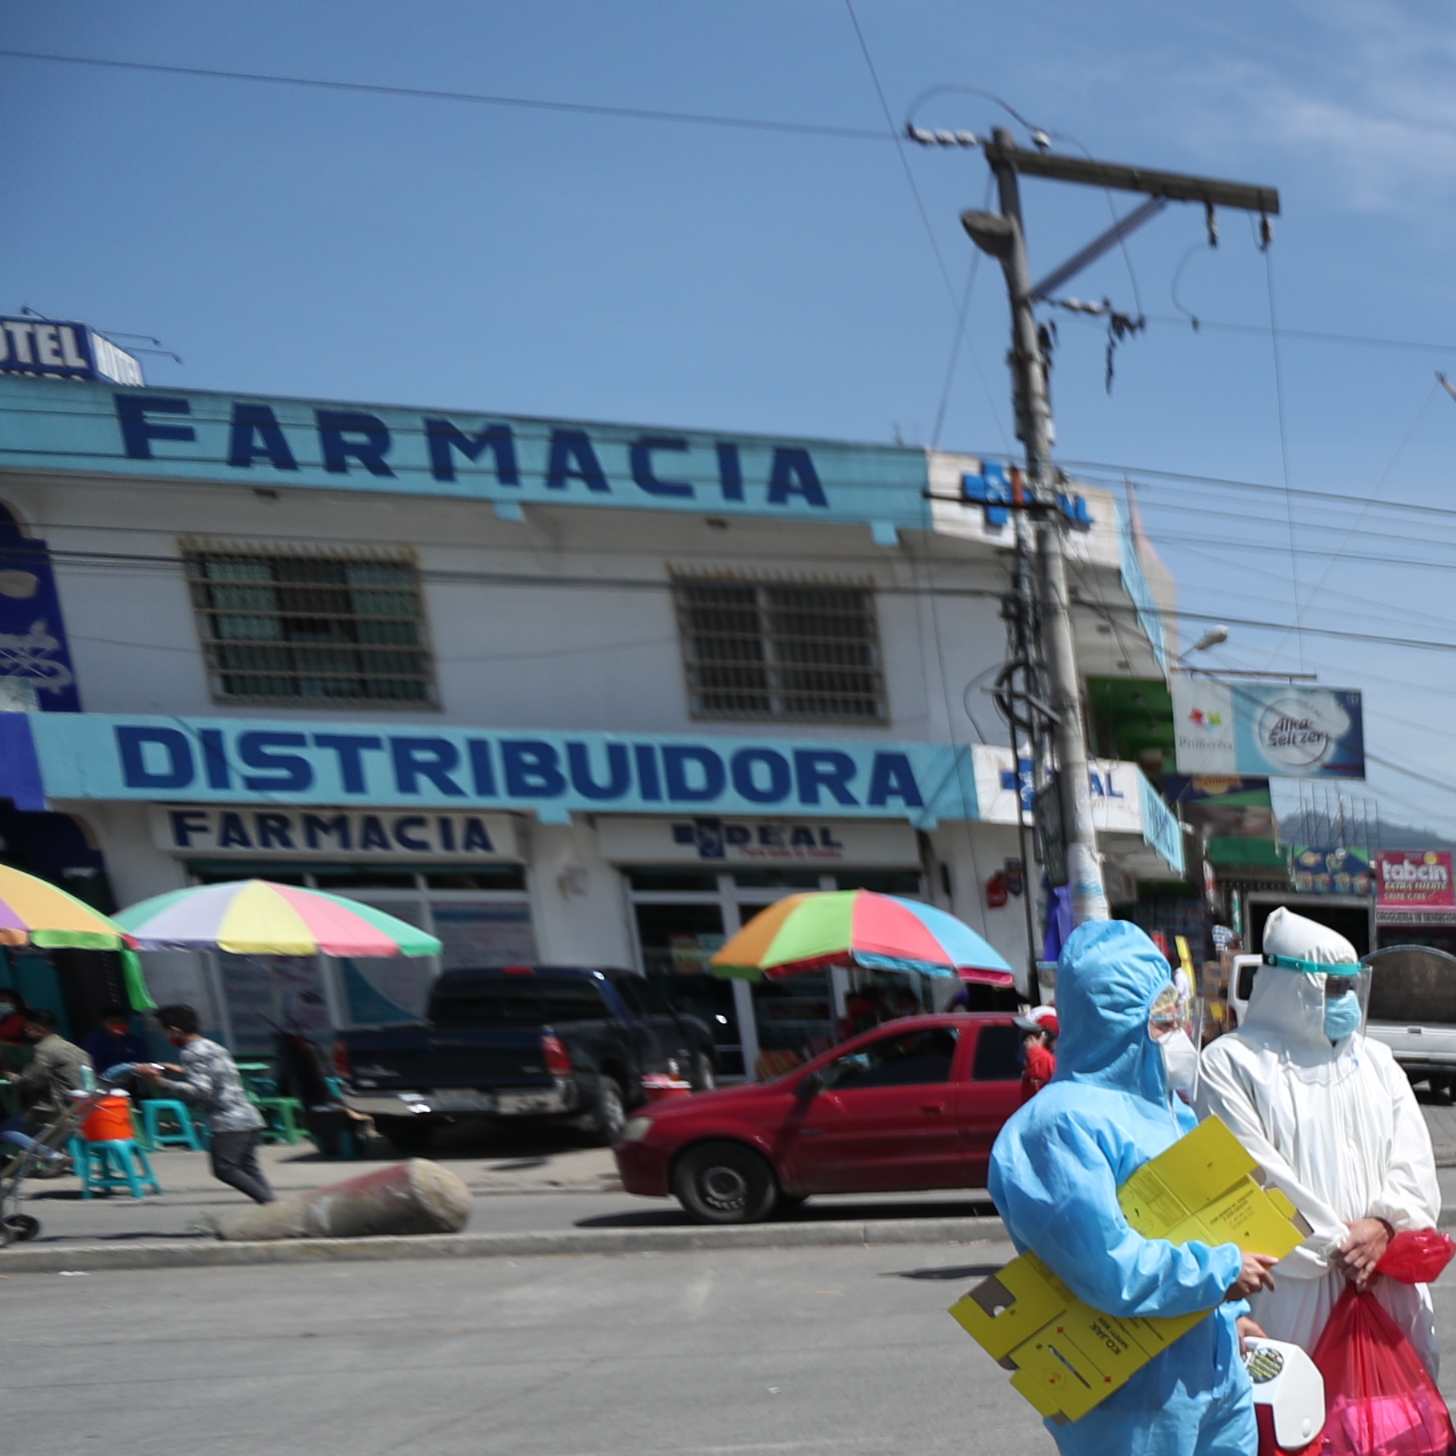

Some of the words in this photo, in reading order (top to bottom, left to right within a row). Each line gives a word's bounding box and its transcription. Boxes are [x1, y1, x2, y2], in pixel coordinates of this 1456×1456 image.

[0, 320, 89, 369] TEL
[112, 393, 829, 508] FARMACIA
[1267, 730, 1326, 747] Seltzer
[112, 725, 926, 808] DISTRIBUIDORA
[168, 810, 496, 855] FARMACIA
[1381, 859, 1448, 882] tabcin
[1384, 880, 1412, 890] EXTRA
[1414, 881, 1448, 891] FUERTE
[1089, 1321, 1123, 1356] KOJAK
